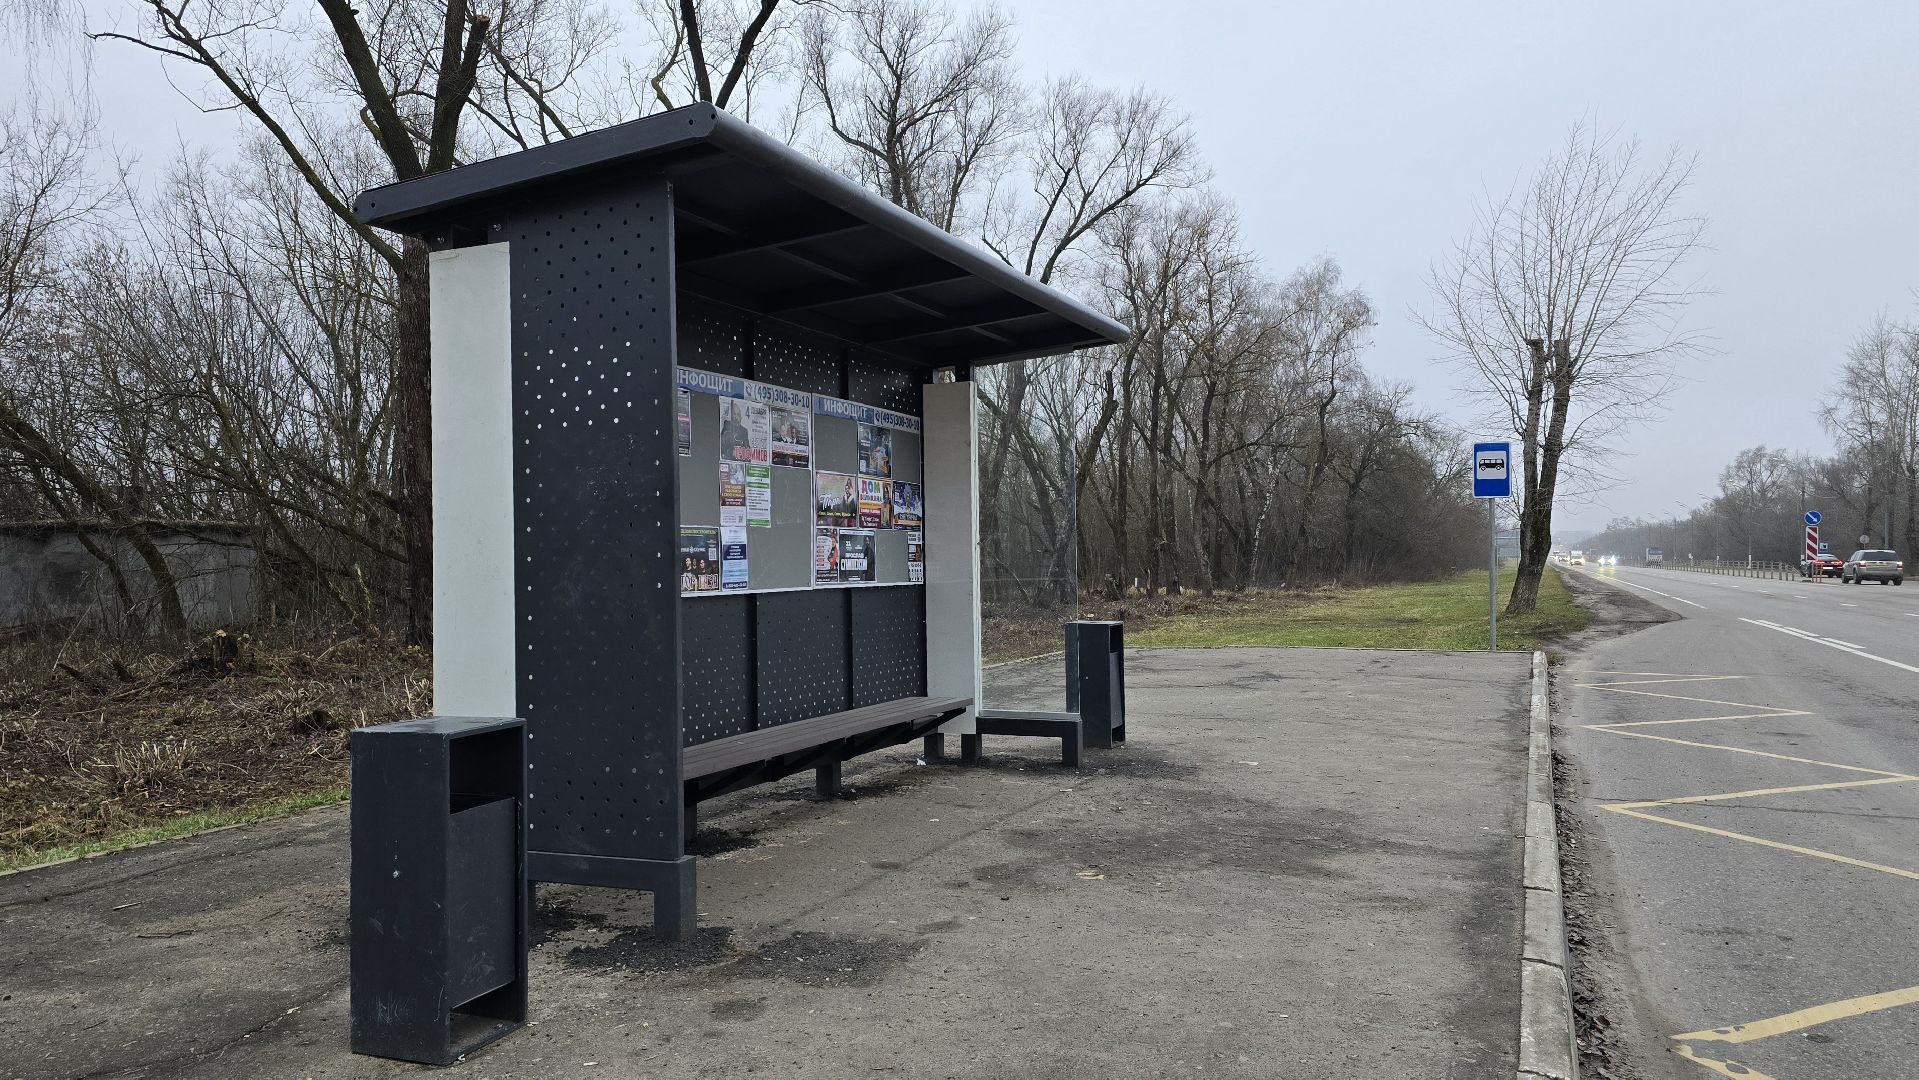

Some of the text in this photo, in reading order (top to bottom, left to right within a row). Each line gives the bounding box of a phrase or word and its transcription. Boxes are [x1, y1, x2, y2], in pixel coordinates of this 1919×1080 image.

[753, 384, 810, 409] (495)308-30-10
[824, 398, 868, 420] ИНФОЩИТ
[861, 480, 881, 495] ДОМ
